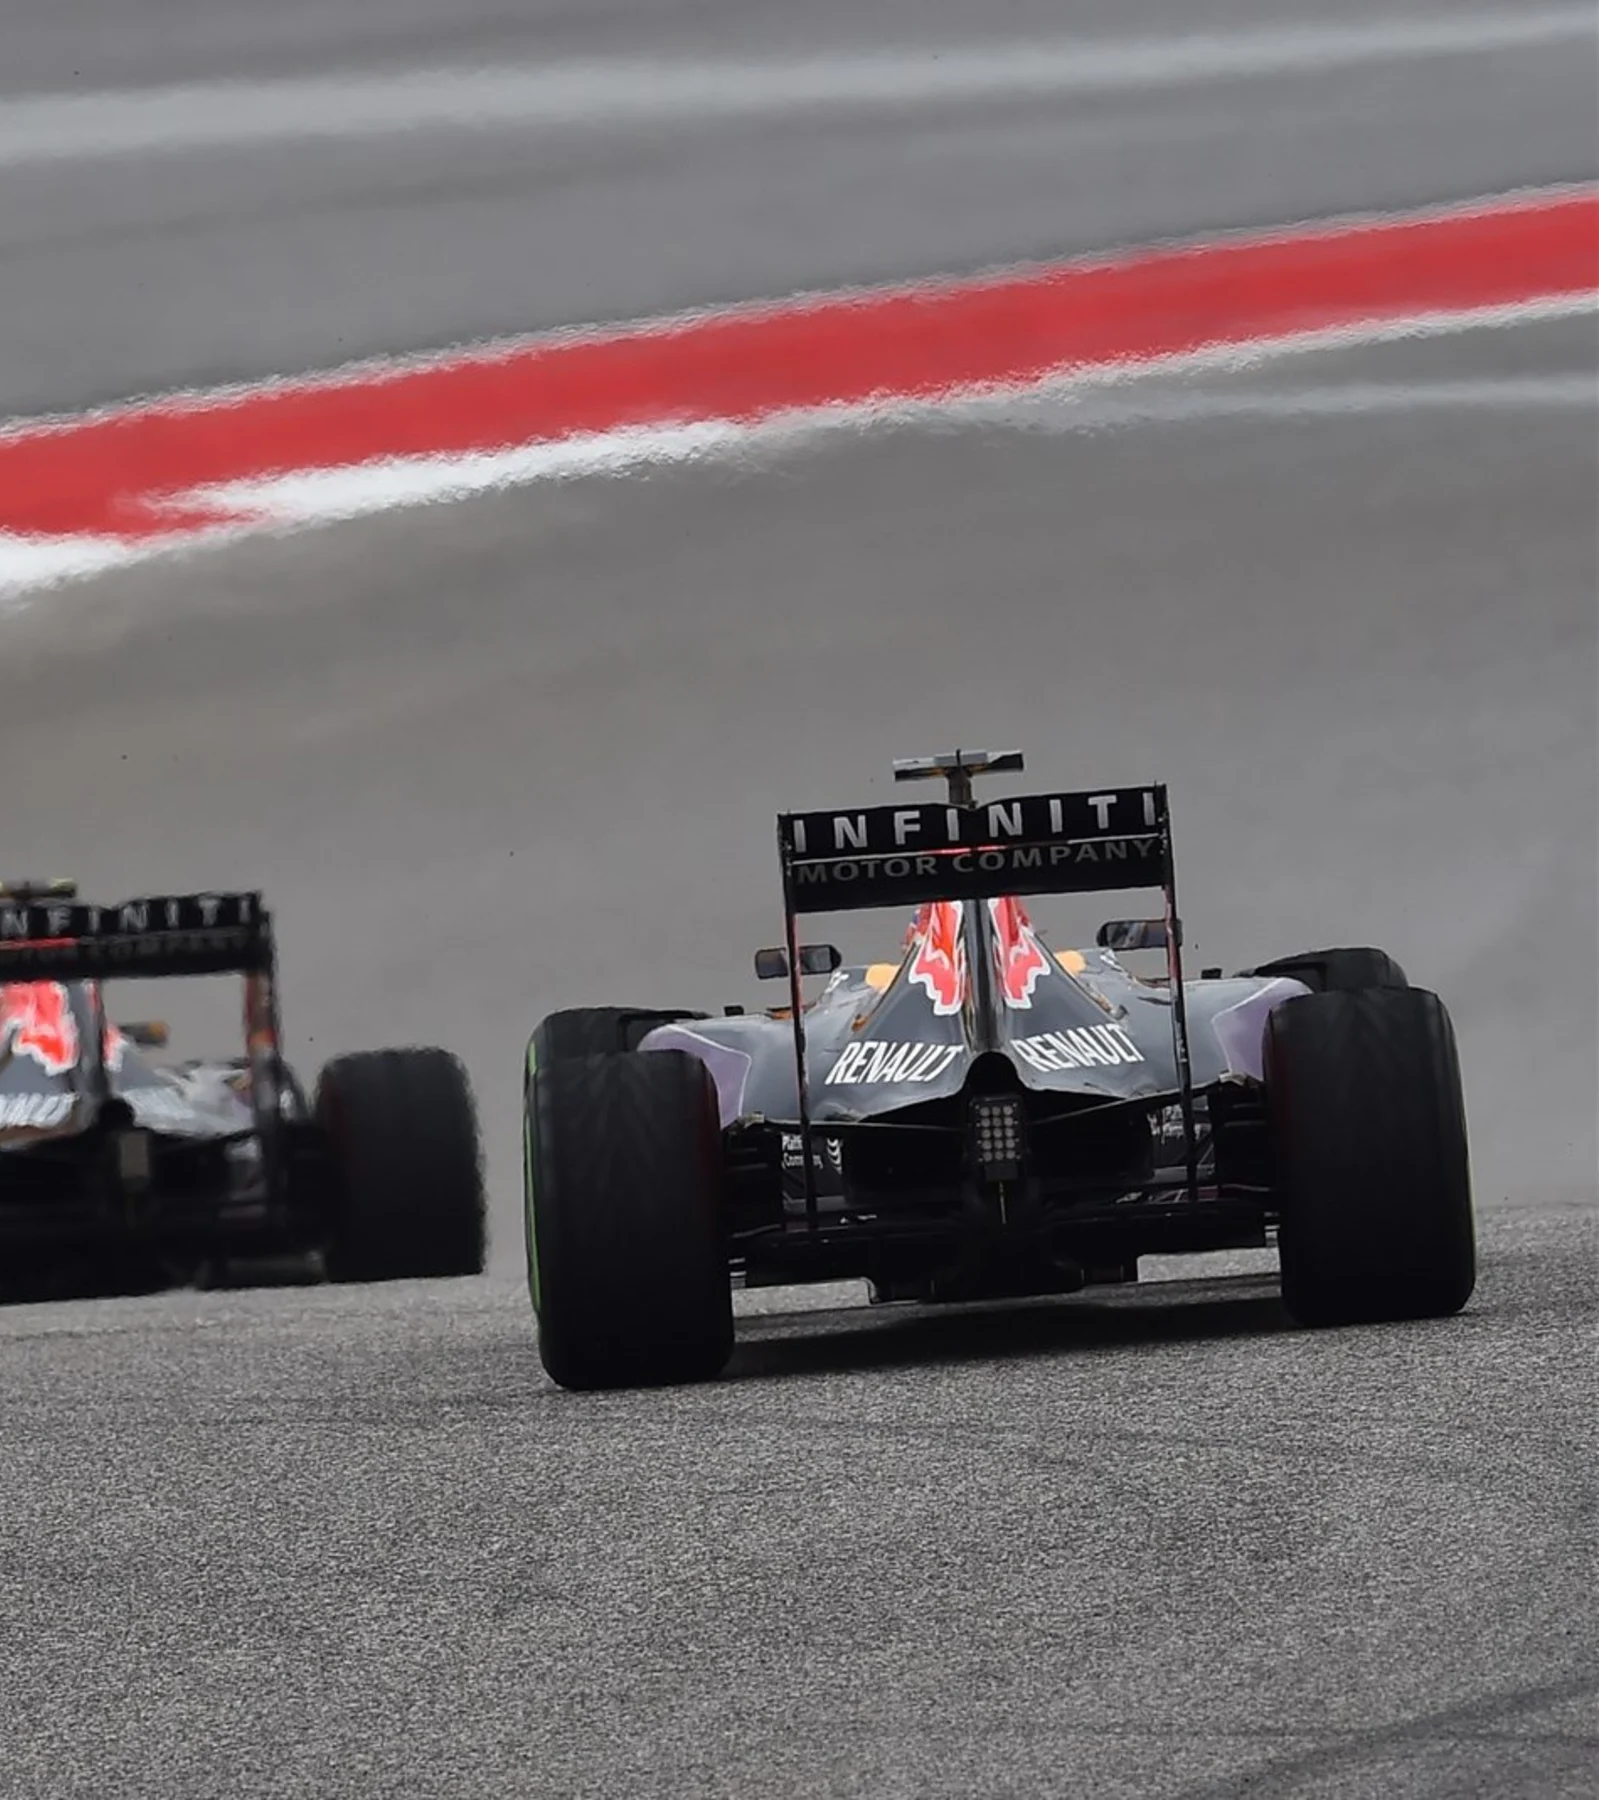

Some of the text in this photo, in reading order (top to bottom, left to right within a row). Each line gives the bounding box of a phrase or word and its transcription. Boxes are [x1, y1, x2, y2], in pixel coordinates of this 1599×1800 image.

[793, 792, 1156, 853] INFINITI
[799, 838, 1156, 884] MOTOR COMPANY
[825, 1041, 964, 1085] RENAULT
[1010, 1023, 1145, 1072] RENAULT
